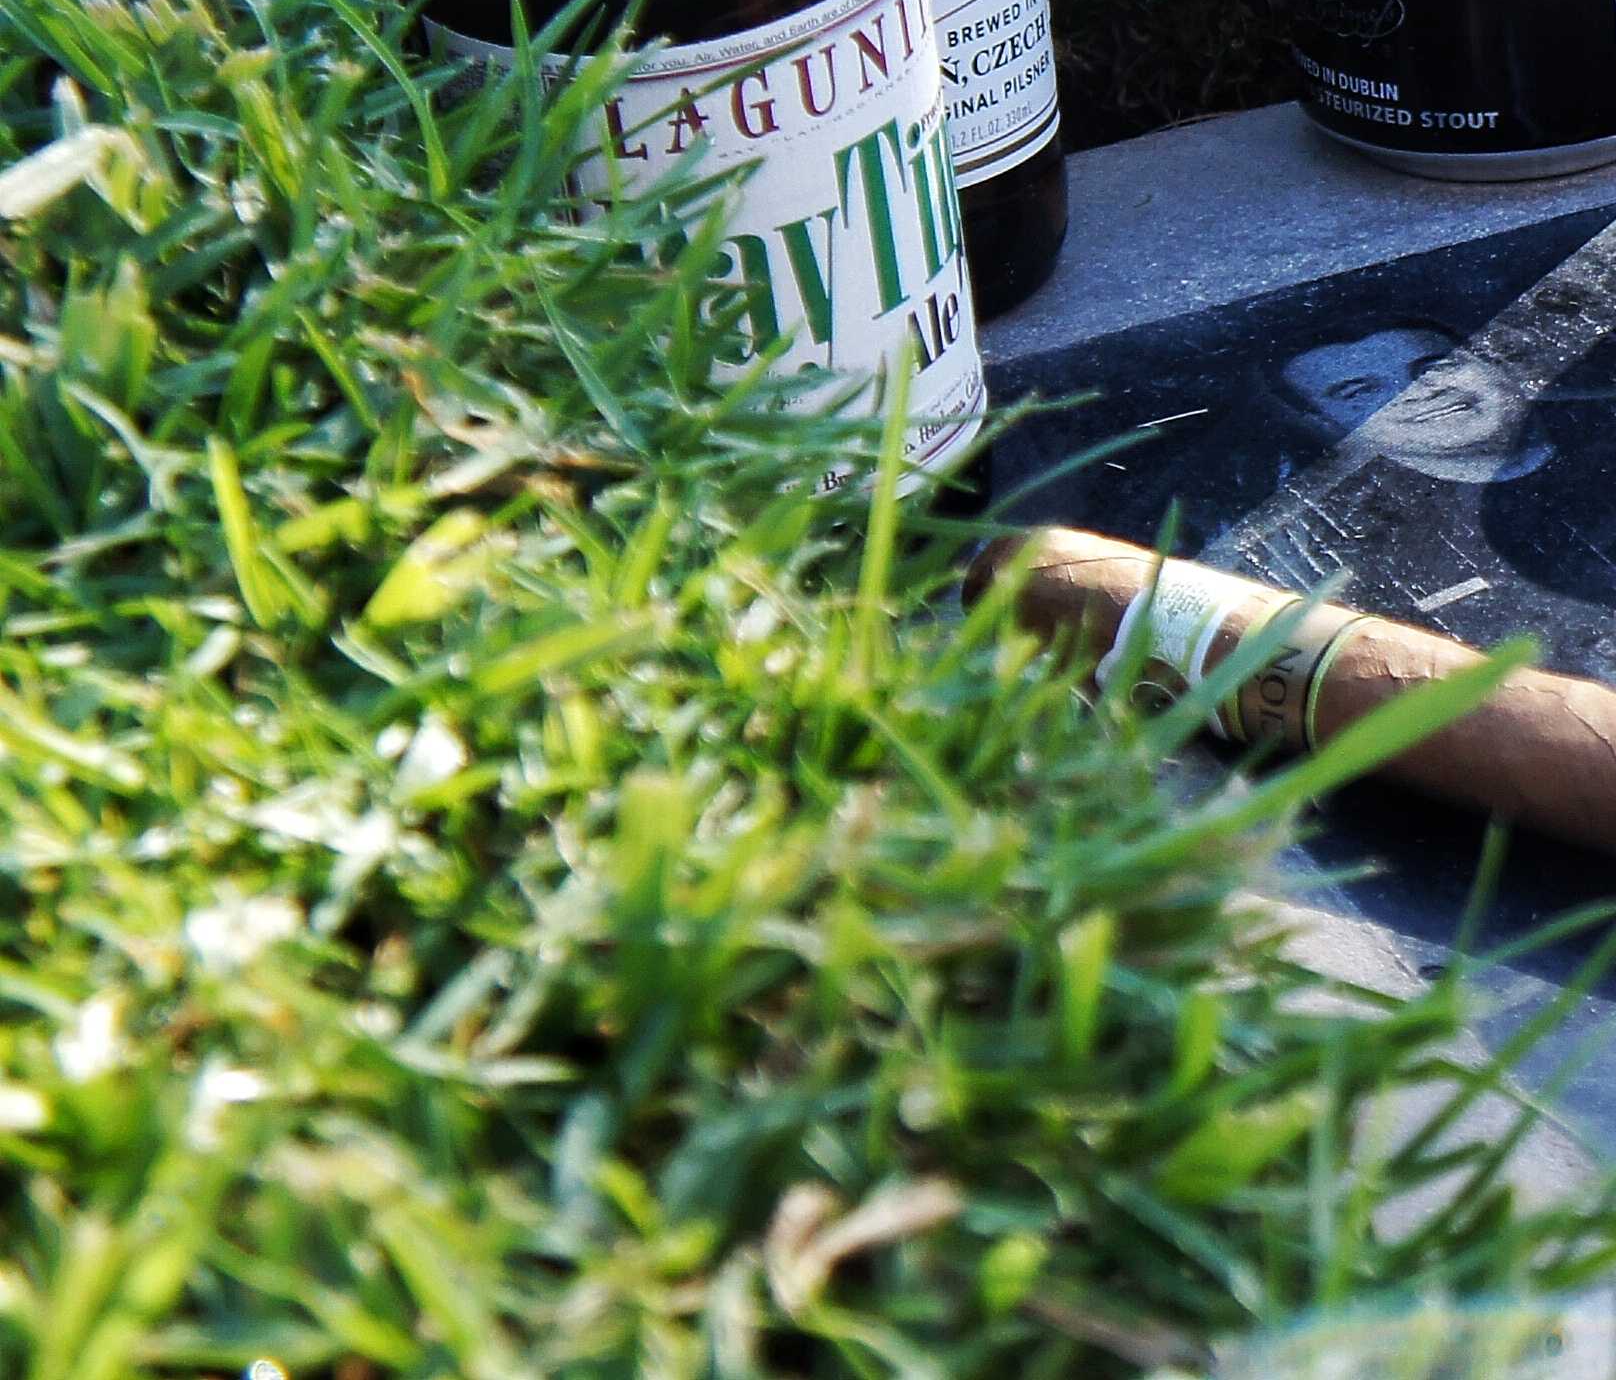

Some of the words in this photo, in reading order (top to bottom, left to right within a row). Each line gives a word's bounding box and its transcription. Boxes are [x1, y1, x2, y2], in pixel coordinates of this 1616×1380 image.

[763, 29, 786, 44] and
[789, 16, 819, 35] Earth
[947, 3, 1020, 48] BREWED
[972, 10, 1046, 77] CZECH
[1004, 50, 1050, 99] PILSNER
[1322, 66, 1336, 86] IN
[1338, 72, 1400, 101] DUBLIN
[1420, 112, 1499, 129] STOUT
